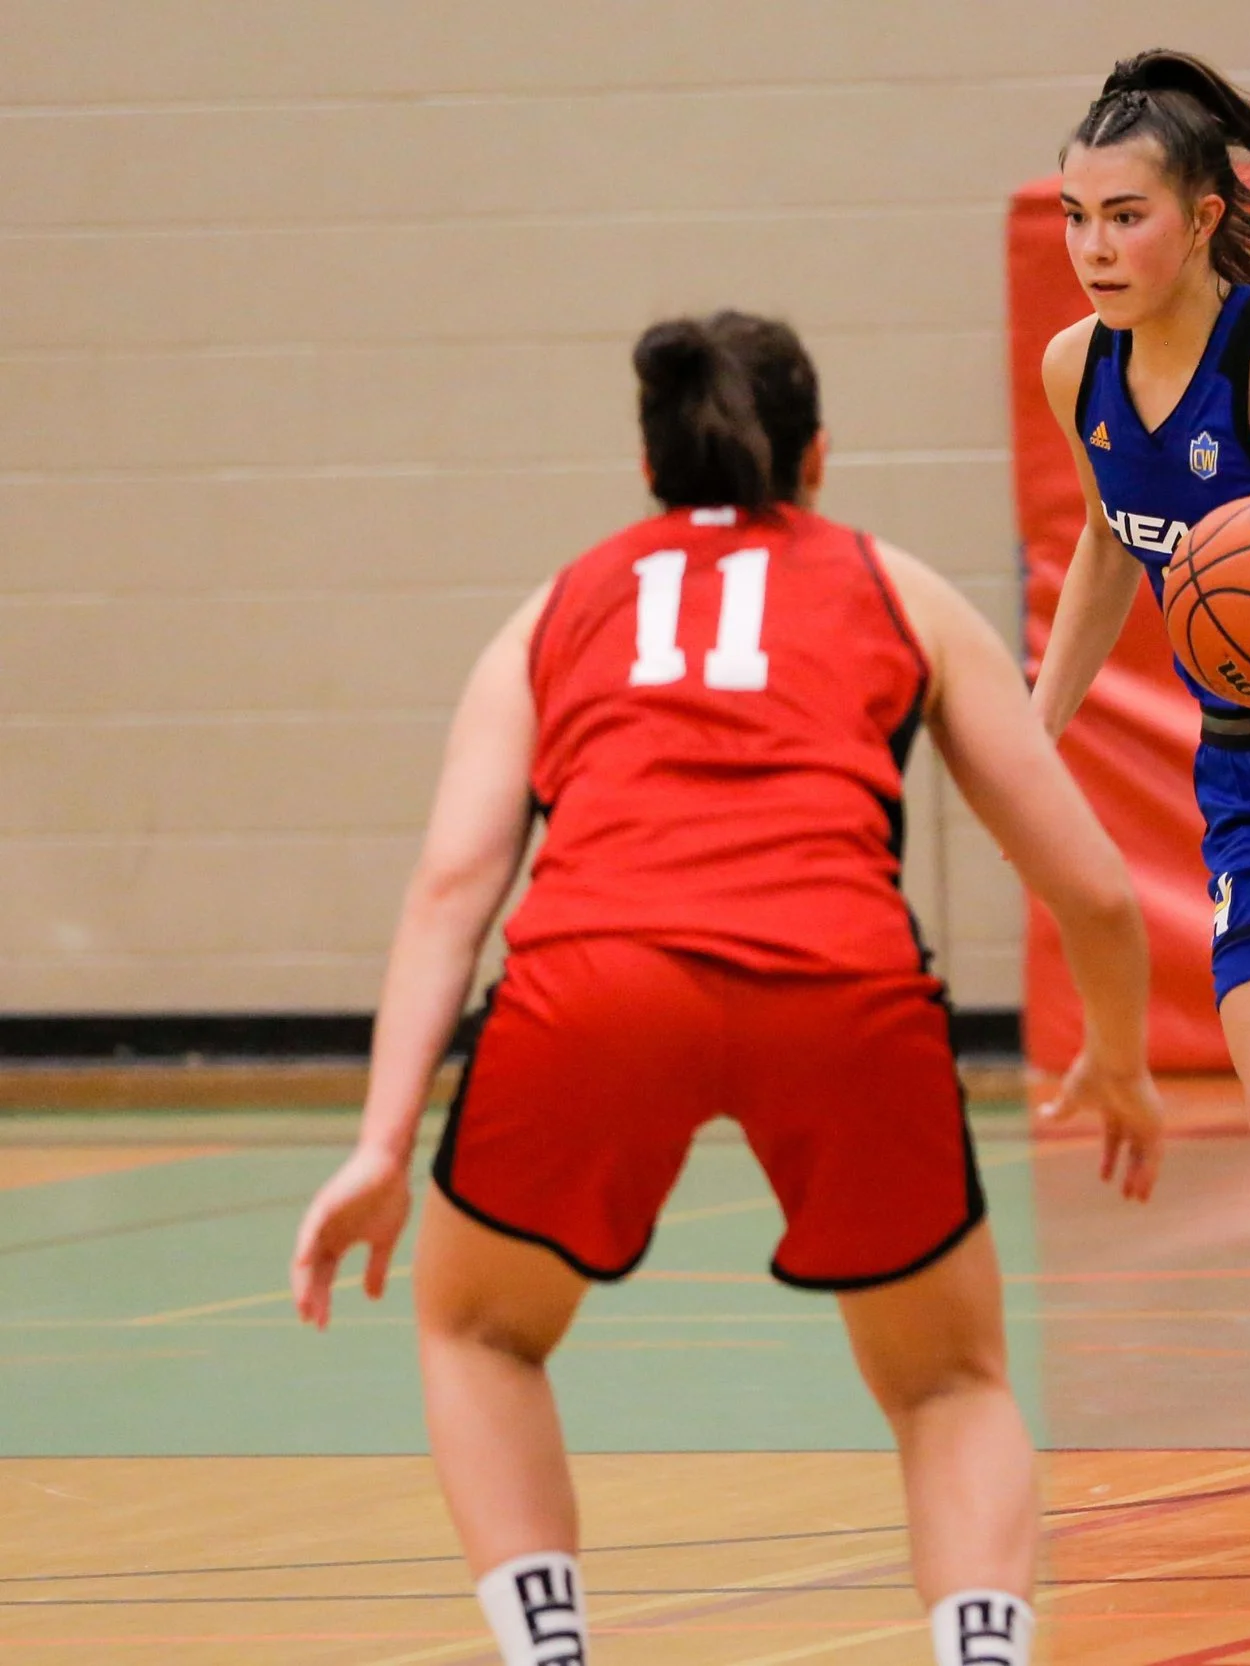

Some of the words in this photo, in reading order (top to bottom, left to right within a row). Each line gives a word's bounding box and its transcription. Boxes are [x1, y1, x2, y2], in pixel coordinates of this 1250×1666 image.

[1193, 448, 1216, 472] CW
[1100, 500, 1191, 554] HEA
[629, 548, 769, 690] 11
